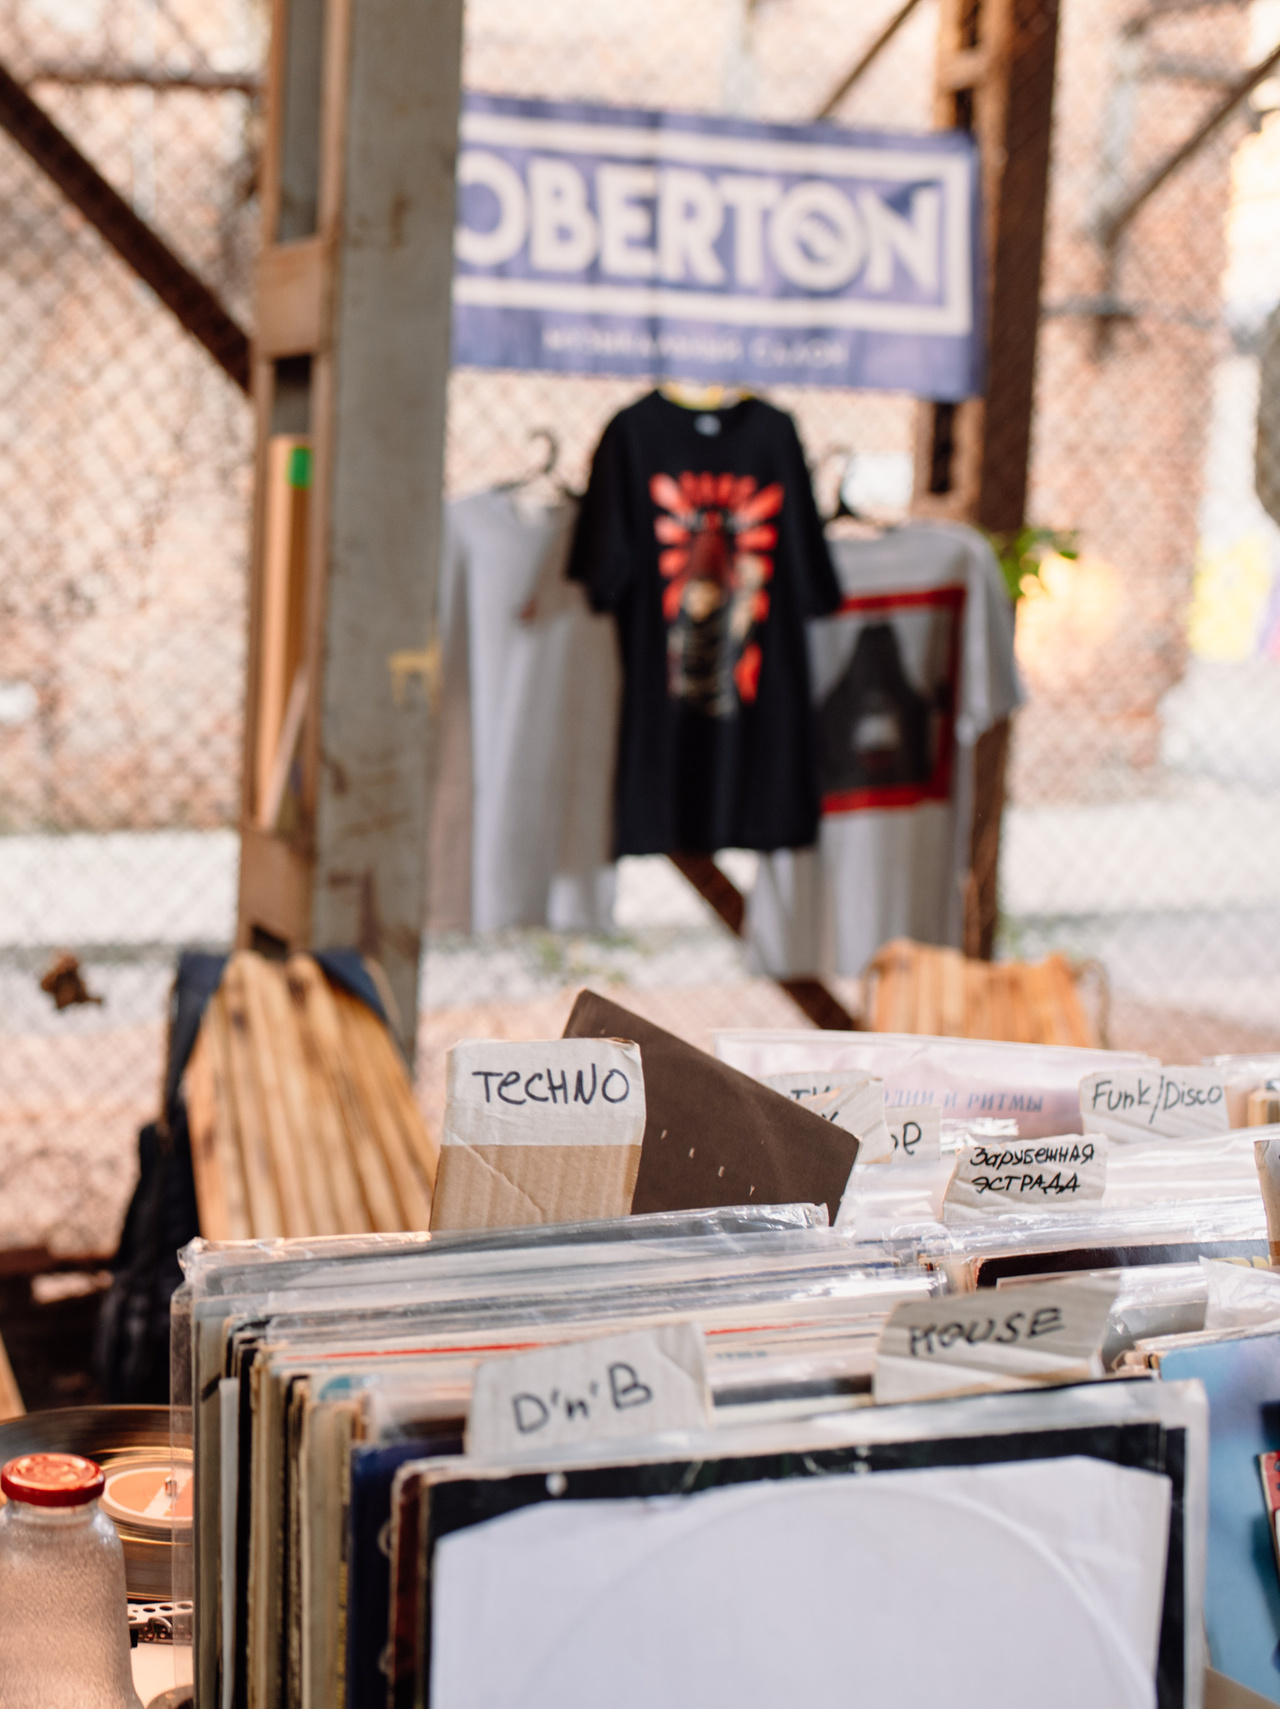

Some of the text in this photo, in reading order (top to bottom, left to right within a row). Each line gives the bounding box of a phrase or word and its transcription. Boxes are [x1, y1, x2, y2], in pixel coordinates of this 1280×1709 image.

[455, 149, 939, 294] OBERTON
[967, 1092, 1045, 1113] РИТМЫ
[970, 1171, 1081, 1195] ЭСТРАДА
[907, 1306, 1066, 1356] HOUSE
